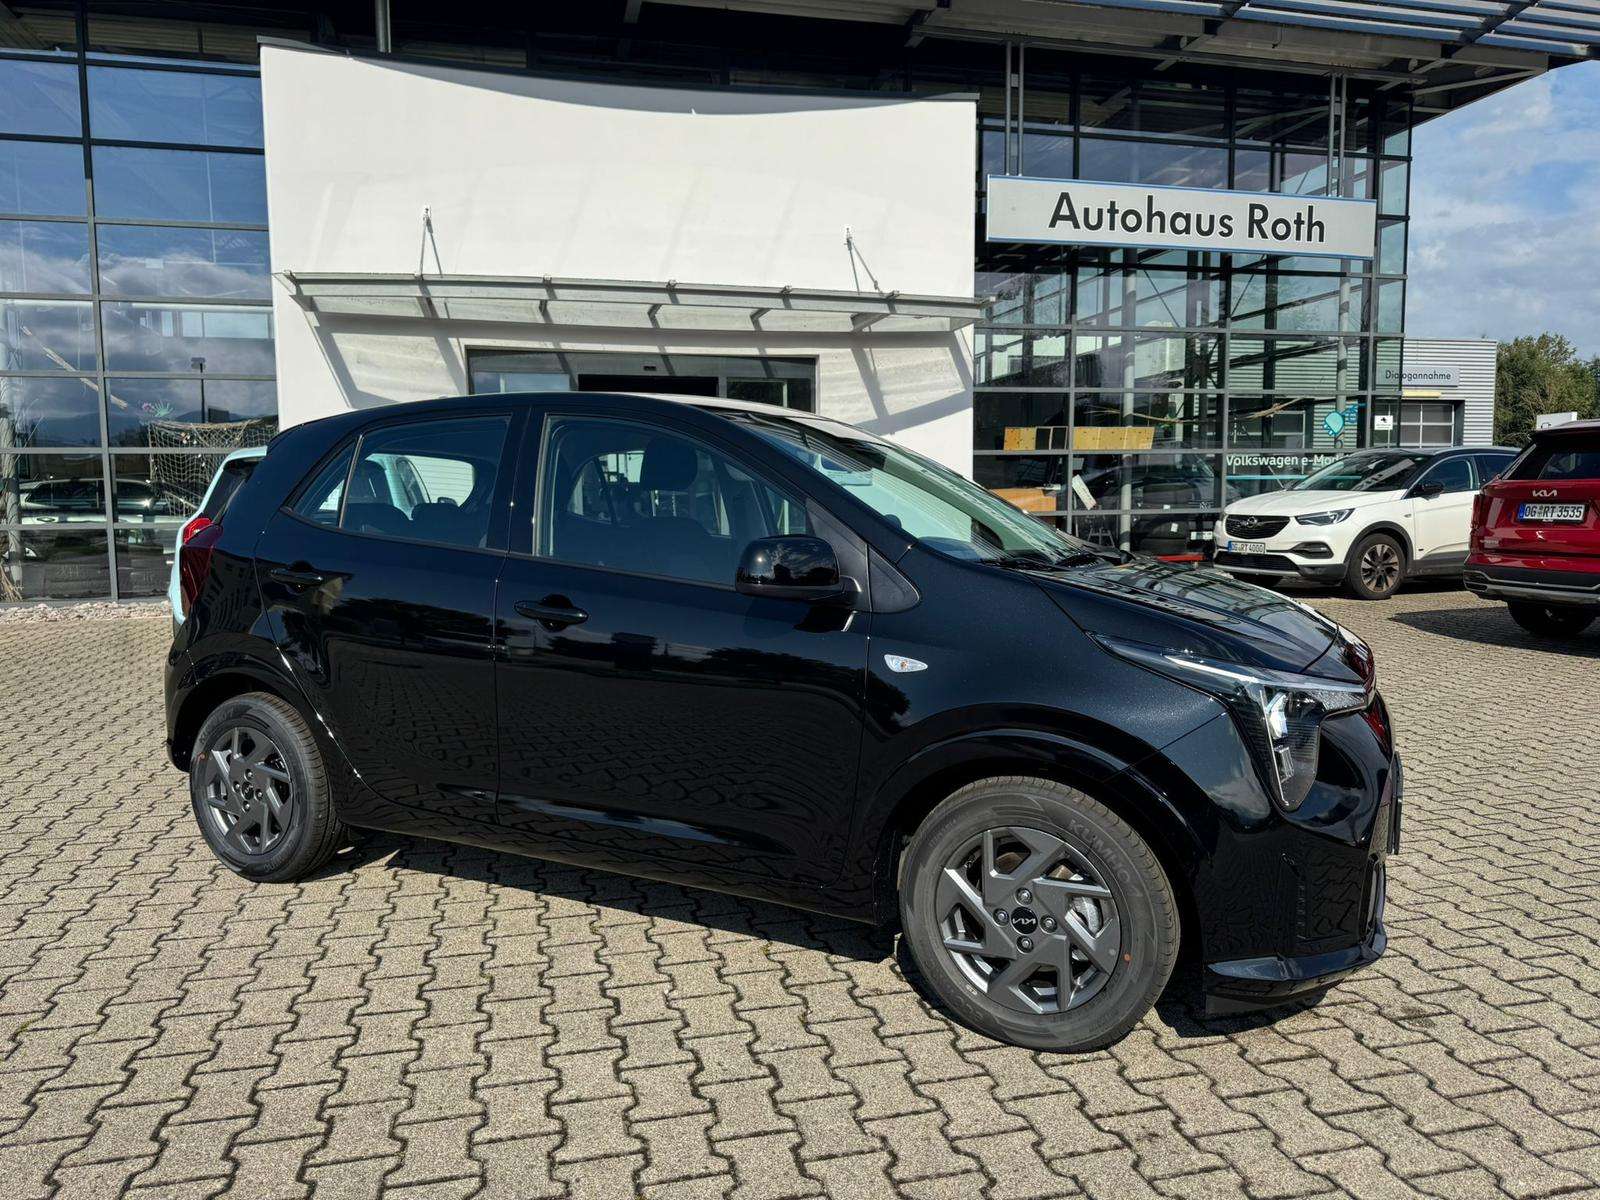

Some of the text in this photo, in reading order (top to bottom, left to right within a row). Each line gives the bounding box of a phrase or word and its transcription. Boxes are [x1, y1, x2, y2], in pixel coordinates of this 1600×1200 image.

[1048, 191, 1326, 243] Autohaus Roth
[1385, 370, 1452, 381] Diaogannahme
[1226, 455, 1298, 468] Volkswagen
[1525, 506, 1582, 518] OG RT 3535
